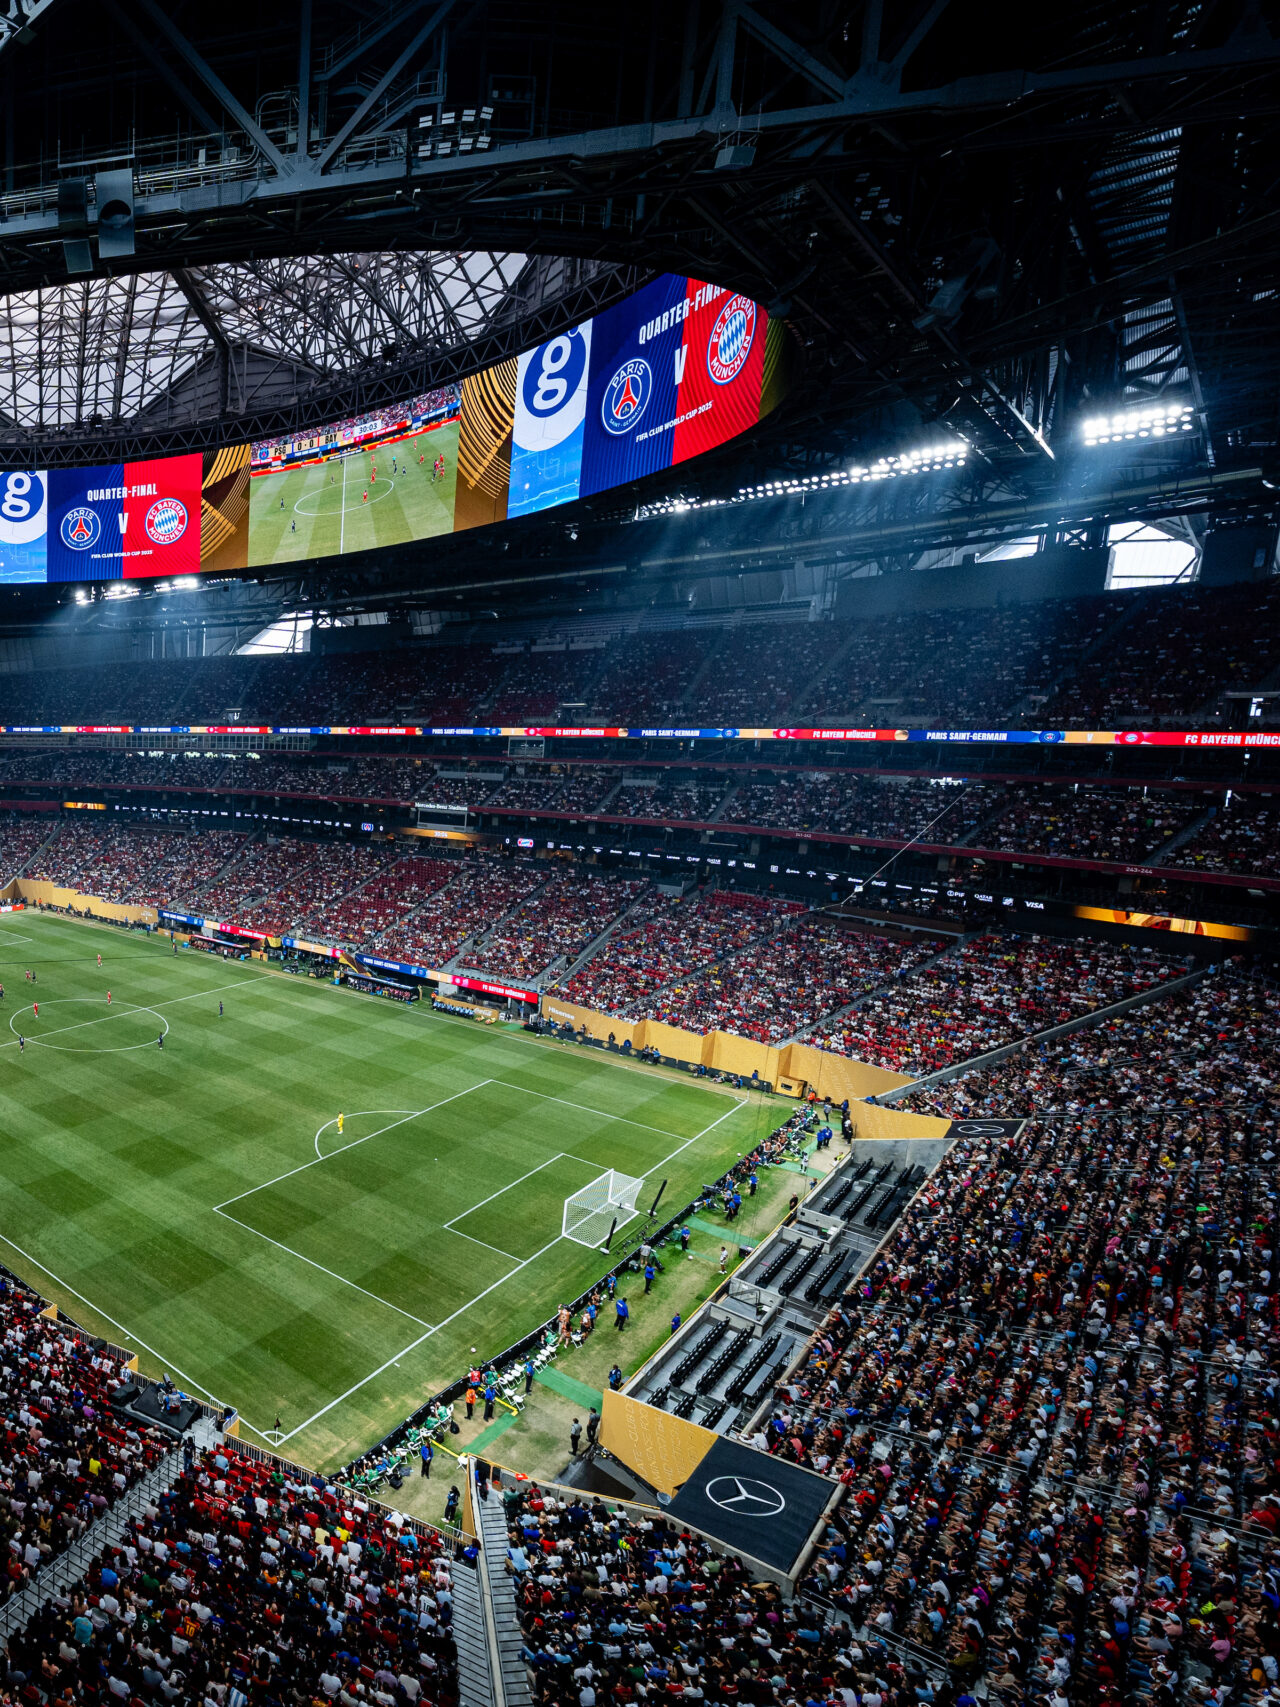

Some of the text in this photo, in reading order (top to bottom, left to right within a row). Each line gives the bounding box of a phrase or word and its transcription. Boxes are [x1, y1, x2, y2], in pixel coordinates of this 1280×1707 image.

[638, 283, 727, 345] QUARTER-FINA
[713, 296, 753, 343] FC BAYERN
[674, 344, 688, 385] V
[611, 361, 646, 388] PARIS
[358, 423, 378, 434] 30:03
[635, 401, 713, 443] FIFA CLUB WORLD CUP 2025
[324, 433, 337, 443] BAY
[274, 446, 286, 455] PSG
[87, 483, 158, 502] QUARTER-FINAL
[67, 509, 95, 521] PARIS
[148, 501, 185, 520] FC BAYERN
[118, 512, 129, 534] V
[658, 729, 700, 737] SAINT-GERMAIN
[846, 730, 877, 739] MÜNCHEN
[926, 731, 1008, 741] PARIS SAINT-GERMAIN
[1086, 733, 1094, 742] V
[1185, 733, 1280, 746] FC BAYERN MÜNC
[414, 802, 447, 810] Mercedes-Benz
[1024, 900, 1044, 910] VISA
[548, 1006, 575, 1020] Hisense
[185, 1625, 195, 1638] 10
